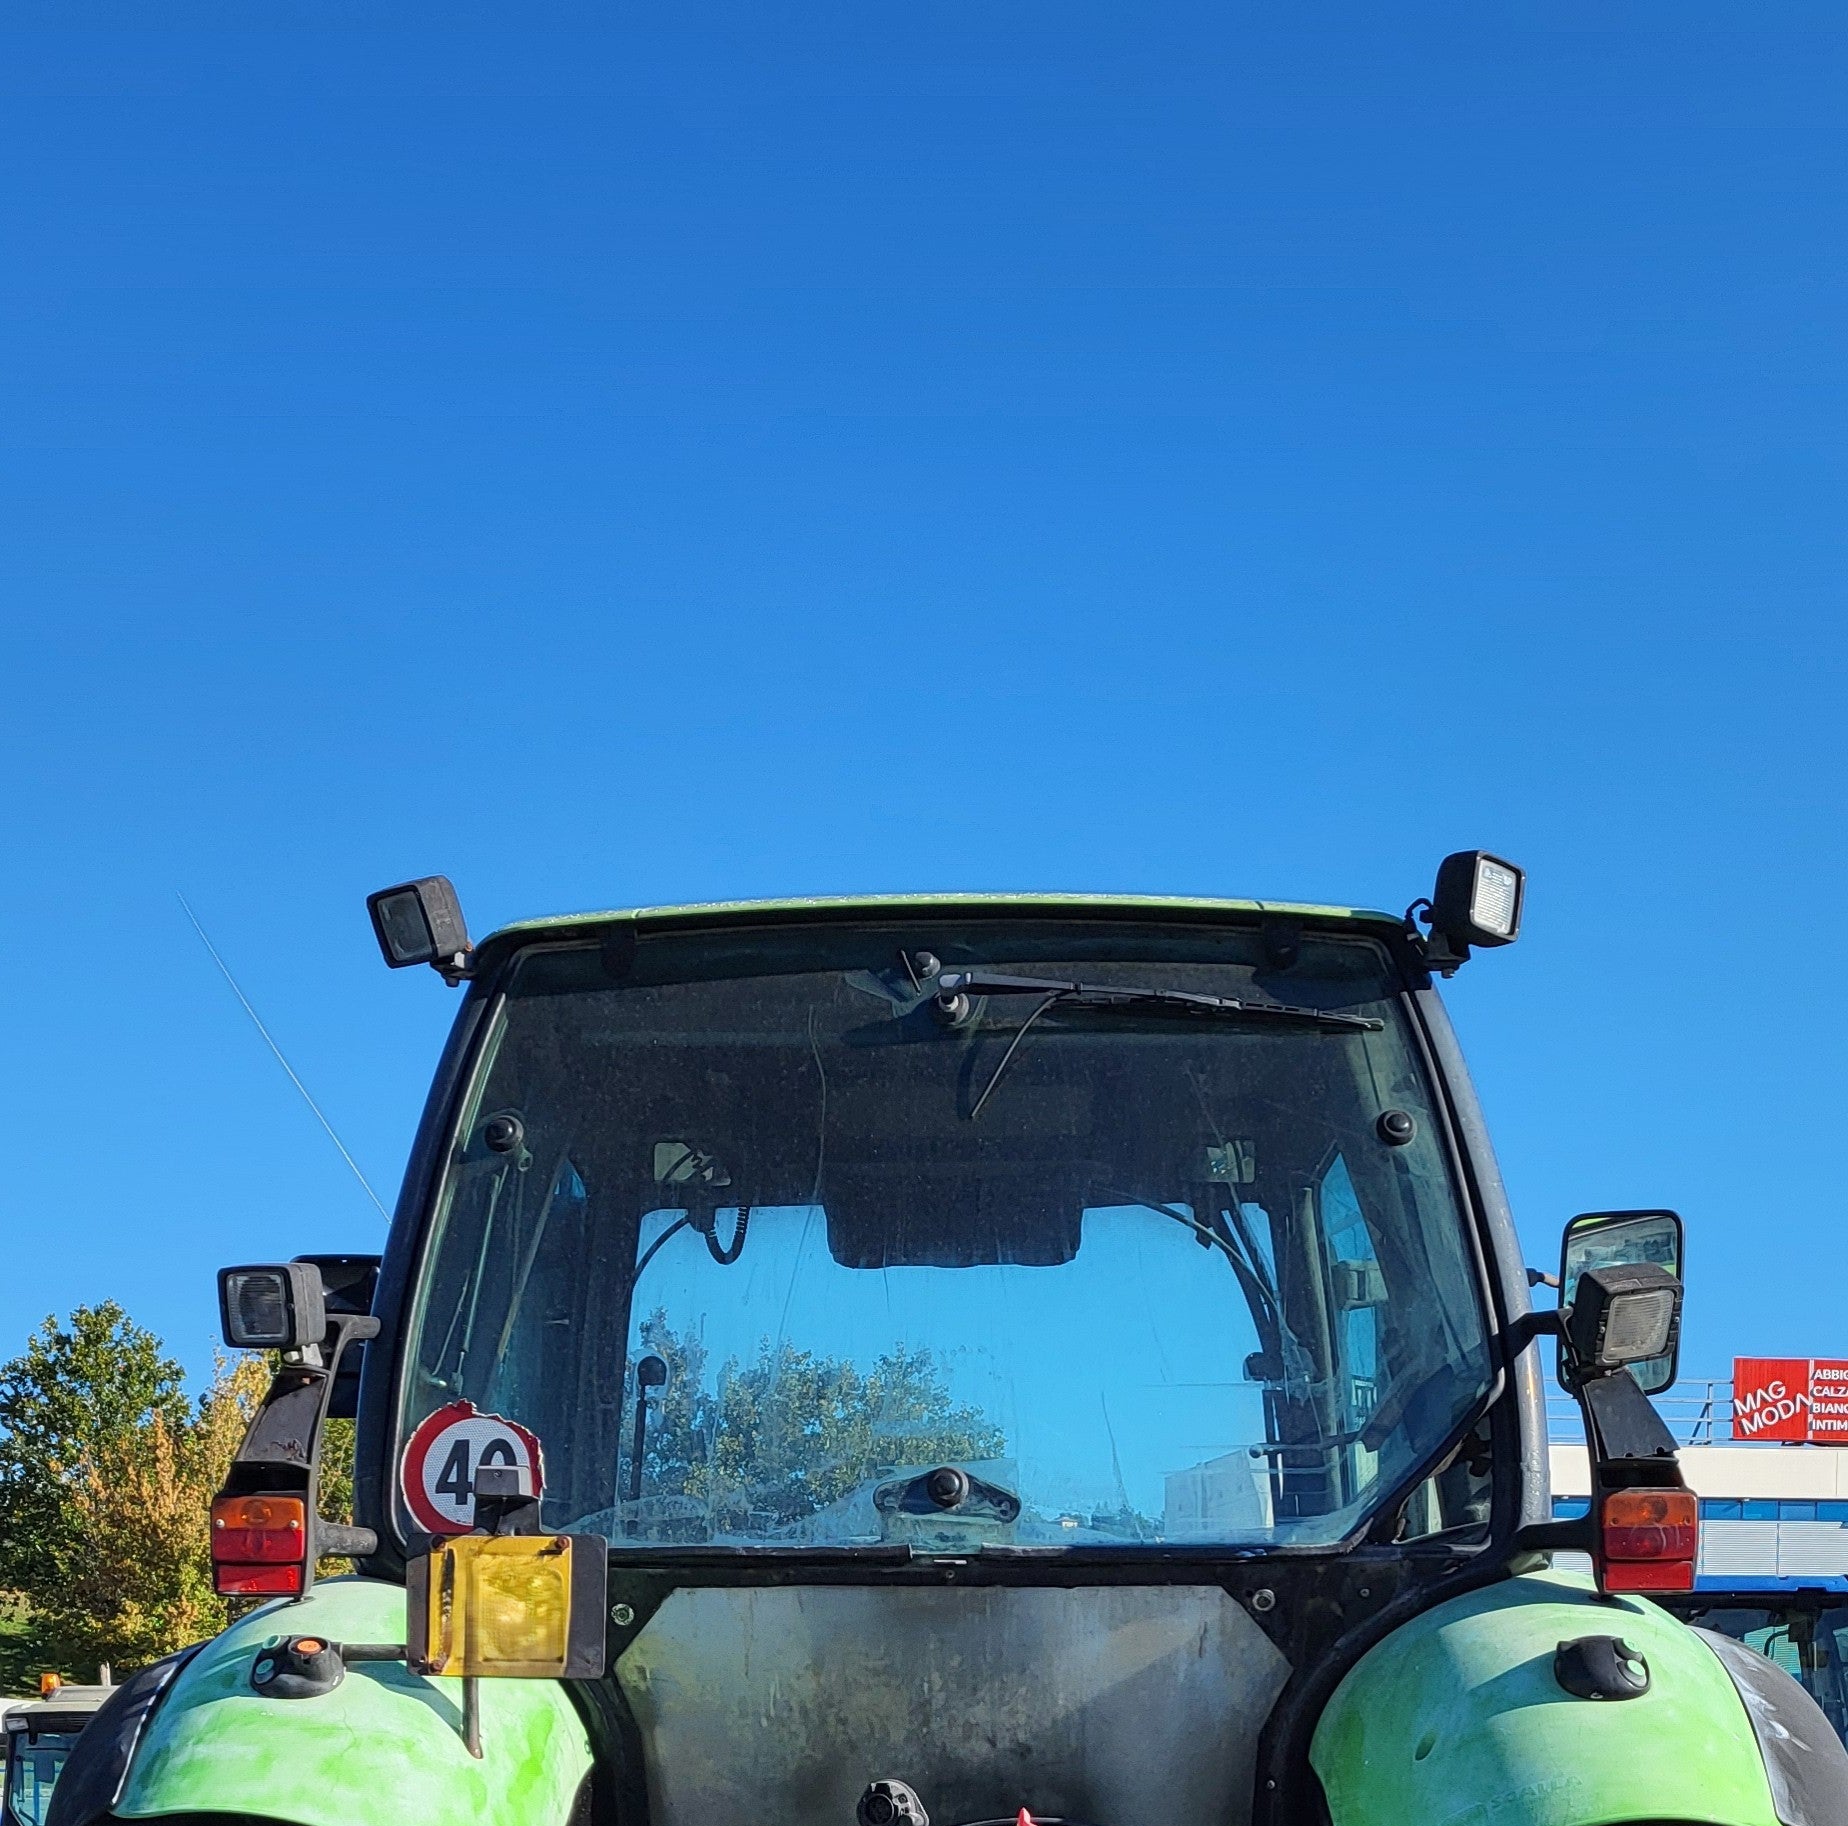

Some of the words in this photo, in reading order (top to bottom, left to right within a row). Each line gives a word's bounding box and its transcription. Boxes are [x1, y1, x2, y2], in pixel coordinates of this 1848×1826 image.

[1734, 1381, 1786, 1416] MAG
[1813, 1386, 1848, 1397] CALZ
[1741, 1393, 1812, 1435] MODA
